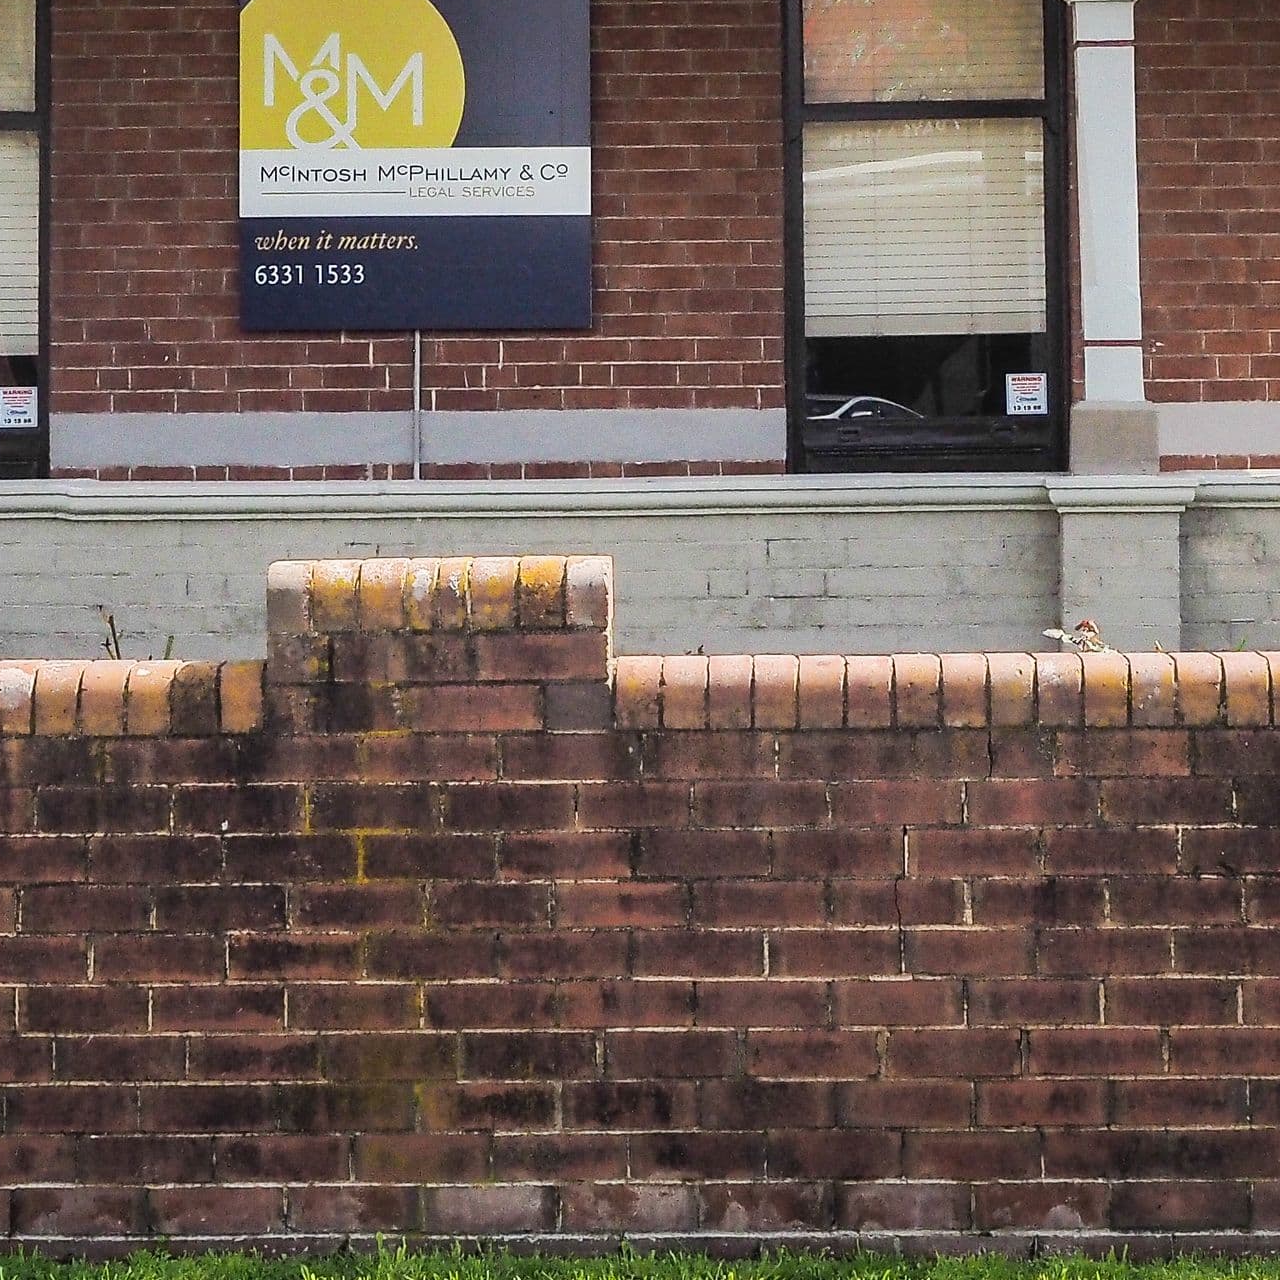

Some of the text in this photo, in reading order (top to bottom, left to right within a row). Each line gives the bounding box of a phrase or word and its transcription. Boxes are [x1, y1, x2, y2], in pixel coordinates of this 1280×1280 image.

[519, 163, 534, 181] &
[409, 185, 536, 198] LEGAL SERVICES
[255, 229, 419, 251] when it matters.
[255, 264, 365, 285] 6331 1533
